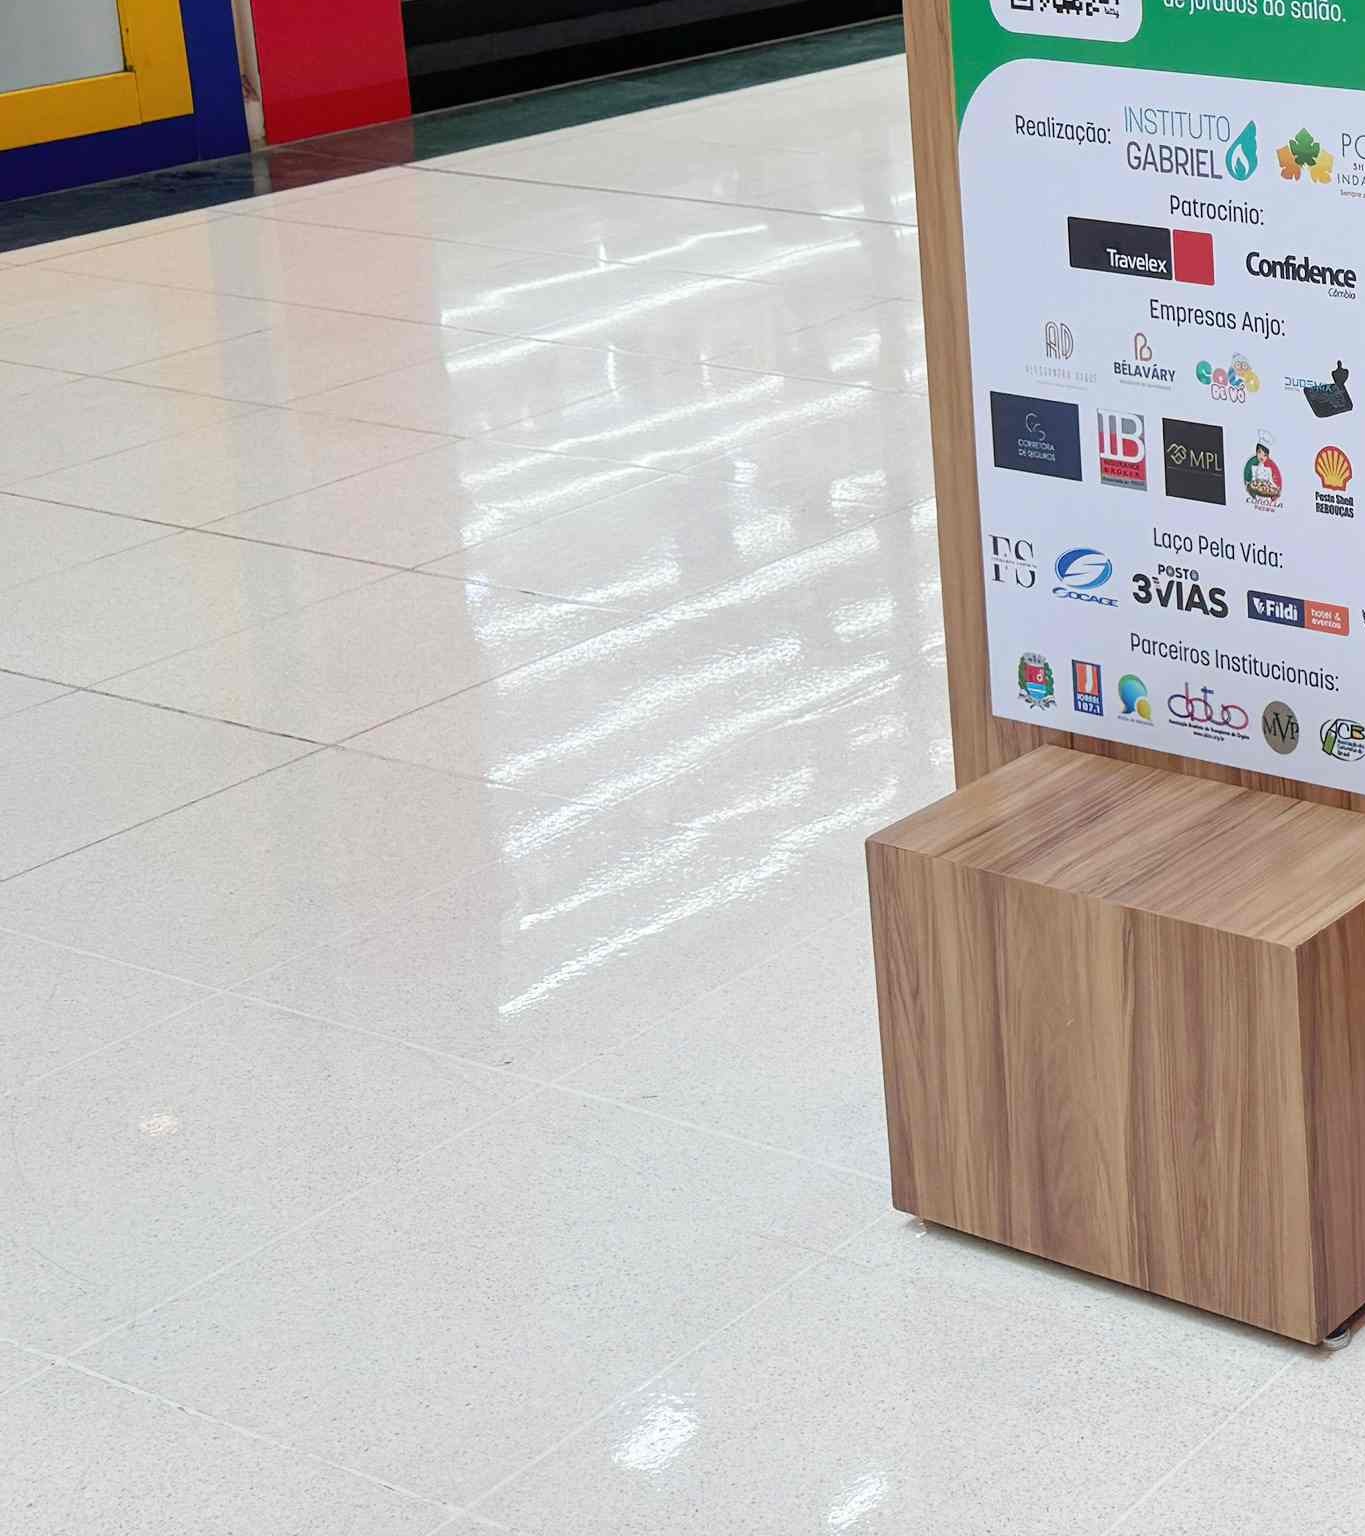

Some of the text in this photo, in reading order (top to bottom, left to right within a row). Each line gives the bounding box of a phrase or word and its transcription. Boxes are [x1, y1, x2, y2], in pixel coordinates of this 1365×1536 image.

[1014, 113, 1112, 146] Realização:
[1123, 105, 1231, 142] INSTITUTO
[1126, 140, 1222, 181] GABRIEL
[1169, 195, 1264, 227] Patrocínio:
[1106, 247, 1357, 289] Travelex Confidence
[1149, 299, 1286, 340] Empresas Anjo:
[1189, 449, 1223, 471] MPL
[1315, 501, 1354, 519] REBOUÇAS
[1153, 527, 1284, 569] Laço Pela Vida:
[1158, 564, 1199, 582] POSTO
[1266, 599, 1298, 621] Fildi
[1311, 608, 1332, 620] hotel
[1311, 617, 1342, 629] eventos
[1130, 632, 1340, 692] Parceiros Institucionais:
